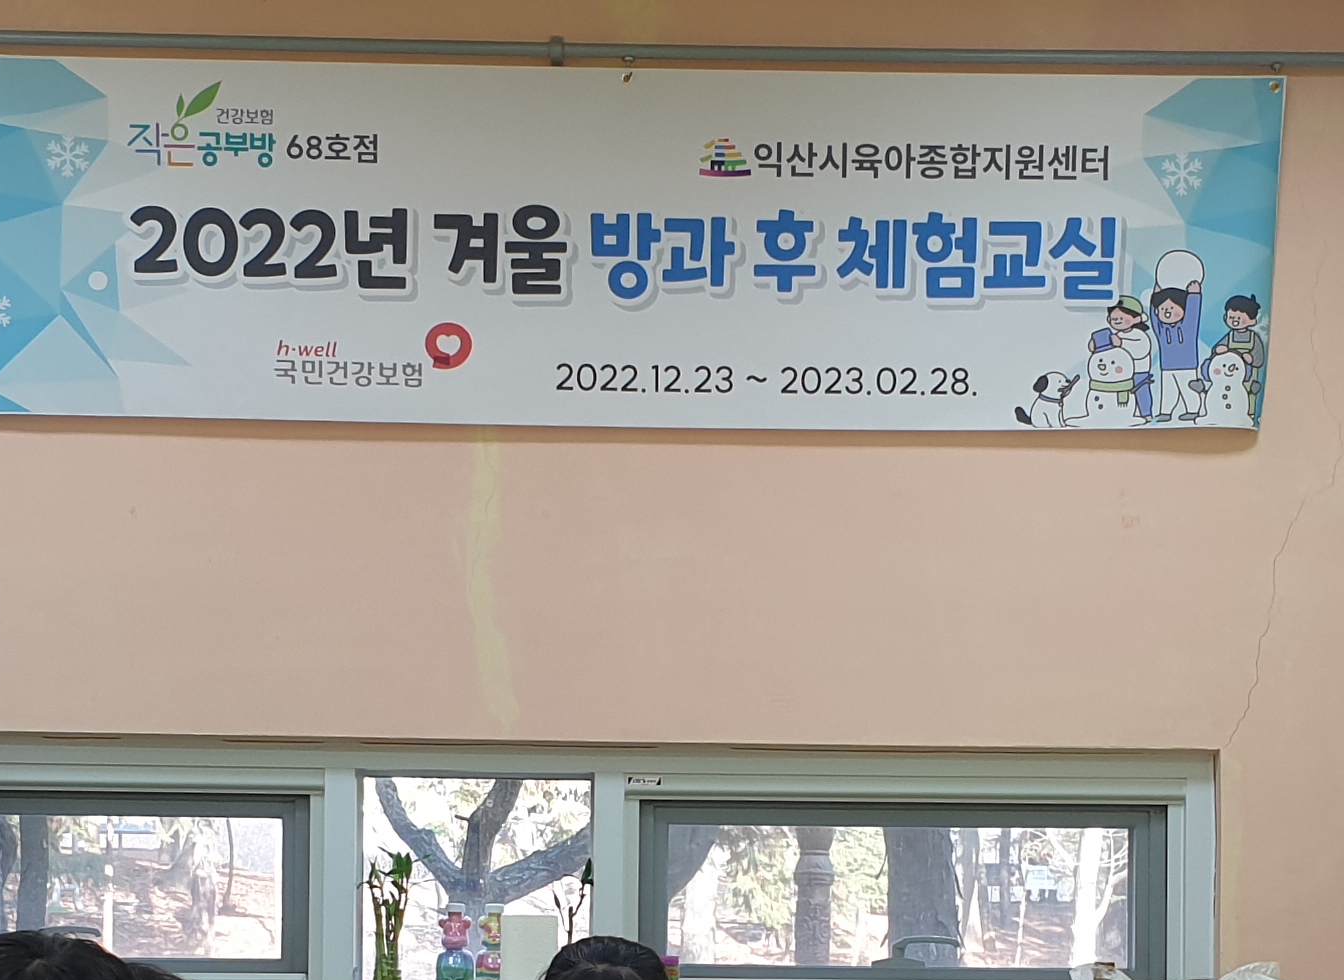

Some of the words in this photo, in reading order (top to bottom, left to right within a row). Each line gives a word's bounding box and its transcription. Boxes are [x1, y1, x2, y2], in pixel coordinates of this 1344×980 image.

[215, 108, 274, 126] 건강보험
[285, 133, 379, 164] 68호점
[754, 141, 1110, 180] 익산시육아종합지원센터
[128, 205, 409, 290] 2022년
[432, 204, 568, 296] 겨울
[589, 212, 736, 300] 방과
[752, 208, 816, 294] 후
[836, 211, 1117, 302] 체험교실
[273, 359, 423, 388] 국민건강보험
[555, 363, 735, 395] 2022.12.23
[780, 366, 979, 397] 2023.02.28.
